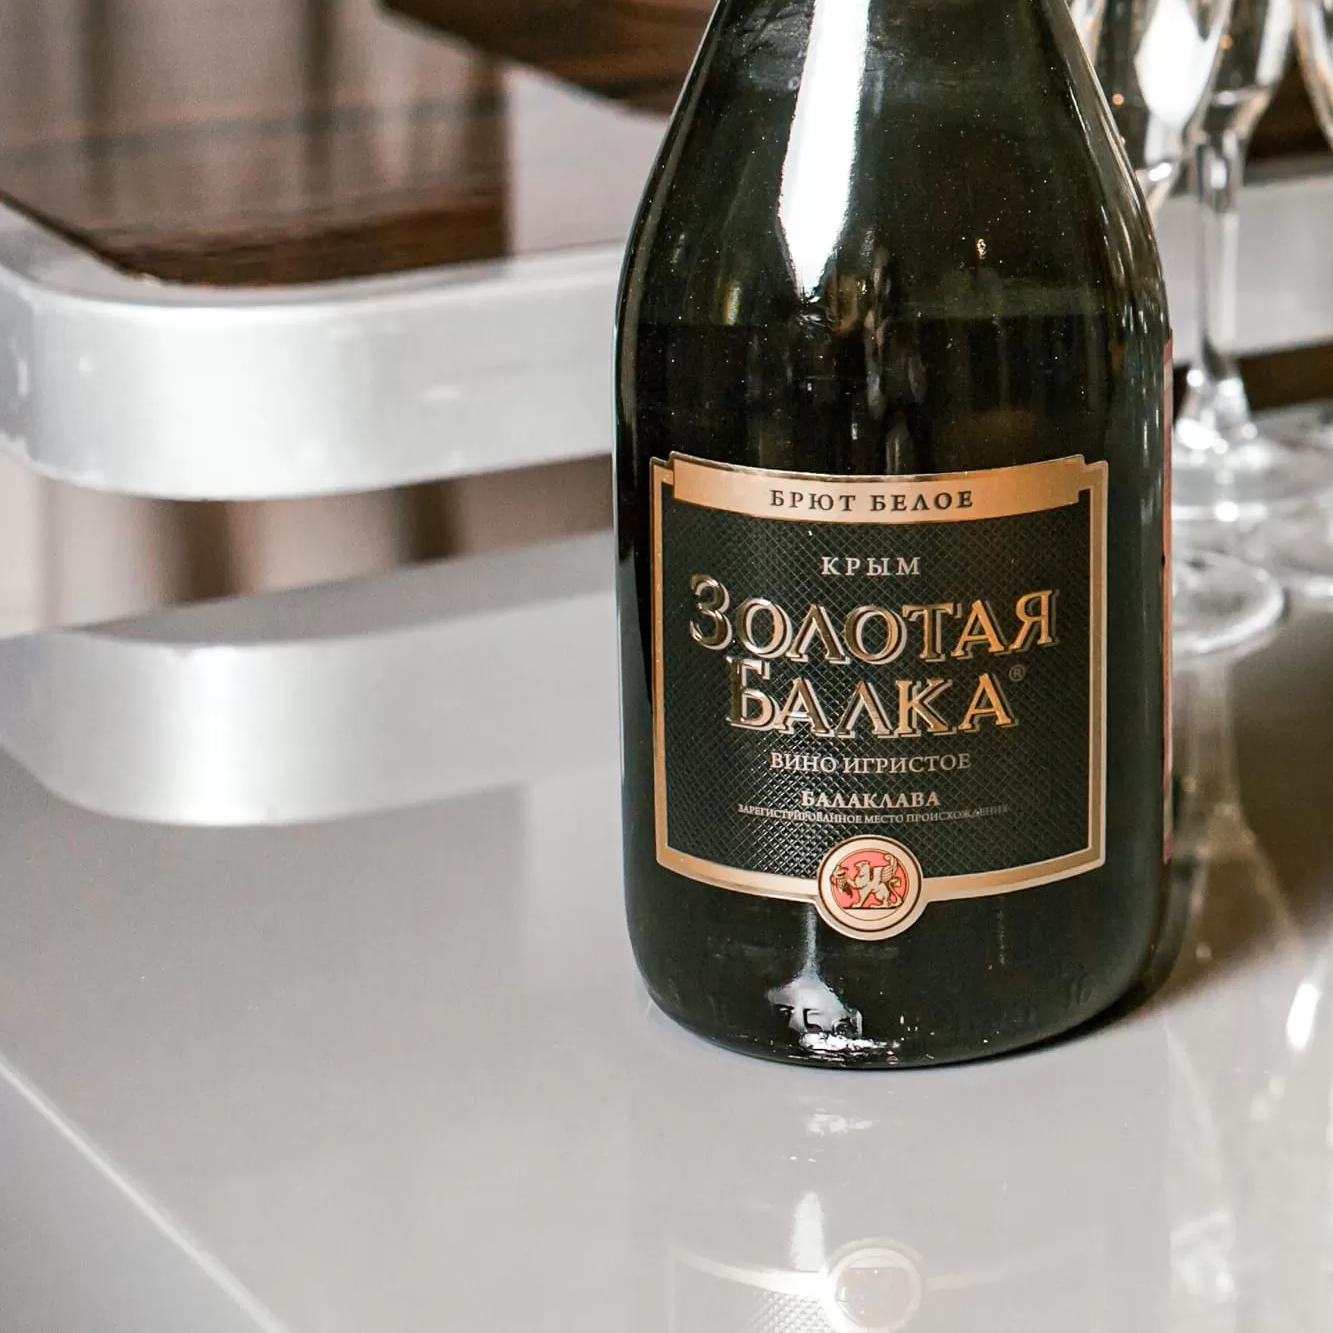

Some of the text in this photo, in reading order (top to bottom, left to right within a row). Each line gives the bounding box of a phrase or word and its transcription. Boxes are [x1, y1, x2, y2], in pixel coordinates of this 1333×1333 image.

[769, 489, 974, 513] БРЮТ БЕЛОЕ
[820, 556, 921, 576] КРЫМ
[688, 573, 1060, 666] ЗОЛОТАЯ
[725, 656, 1019, 739] БАЛКА
[769, 751, 972, 775] ВИНО ИГРИСТОЕ
[801, 790, 942, 810] БАЛАКЛАВА
[864, 813, 905, 825] МЕСТО
